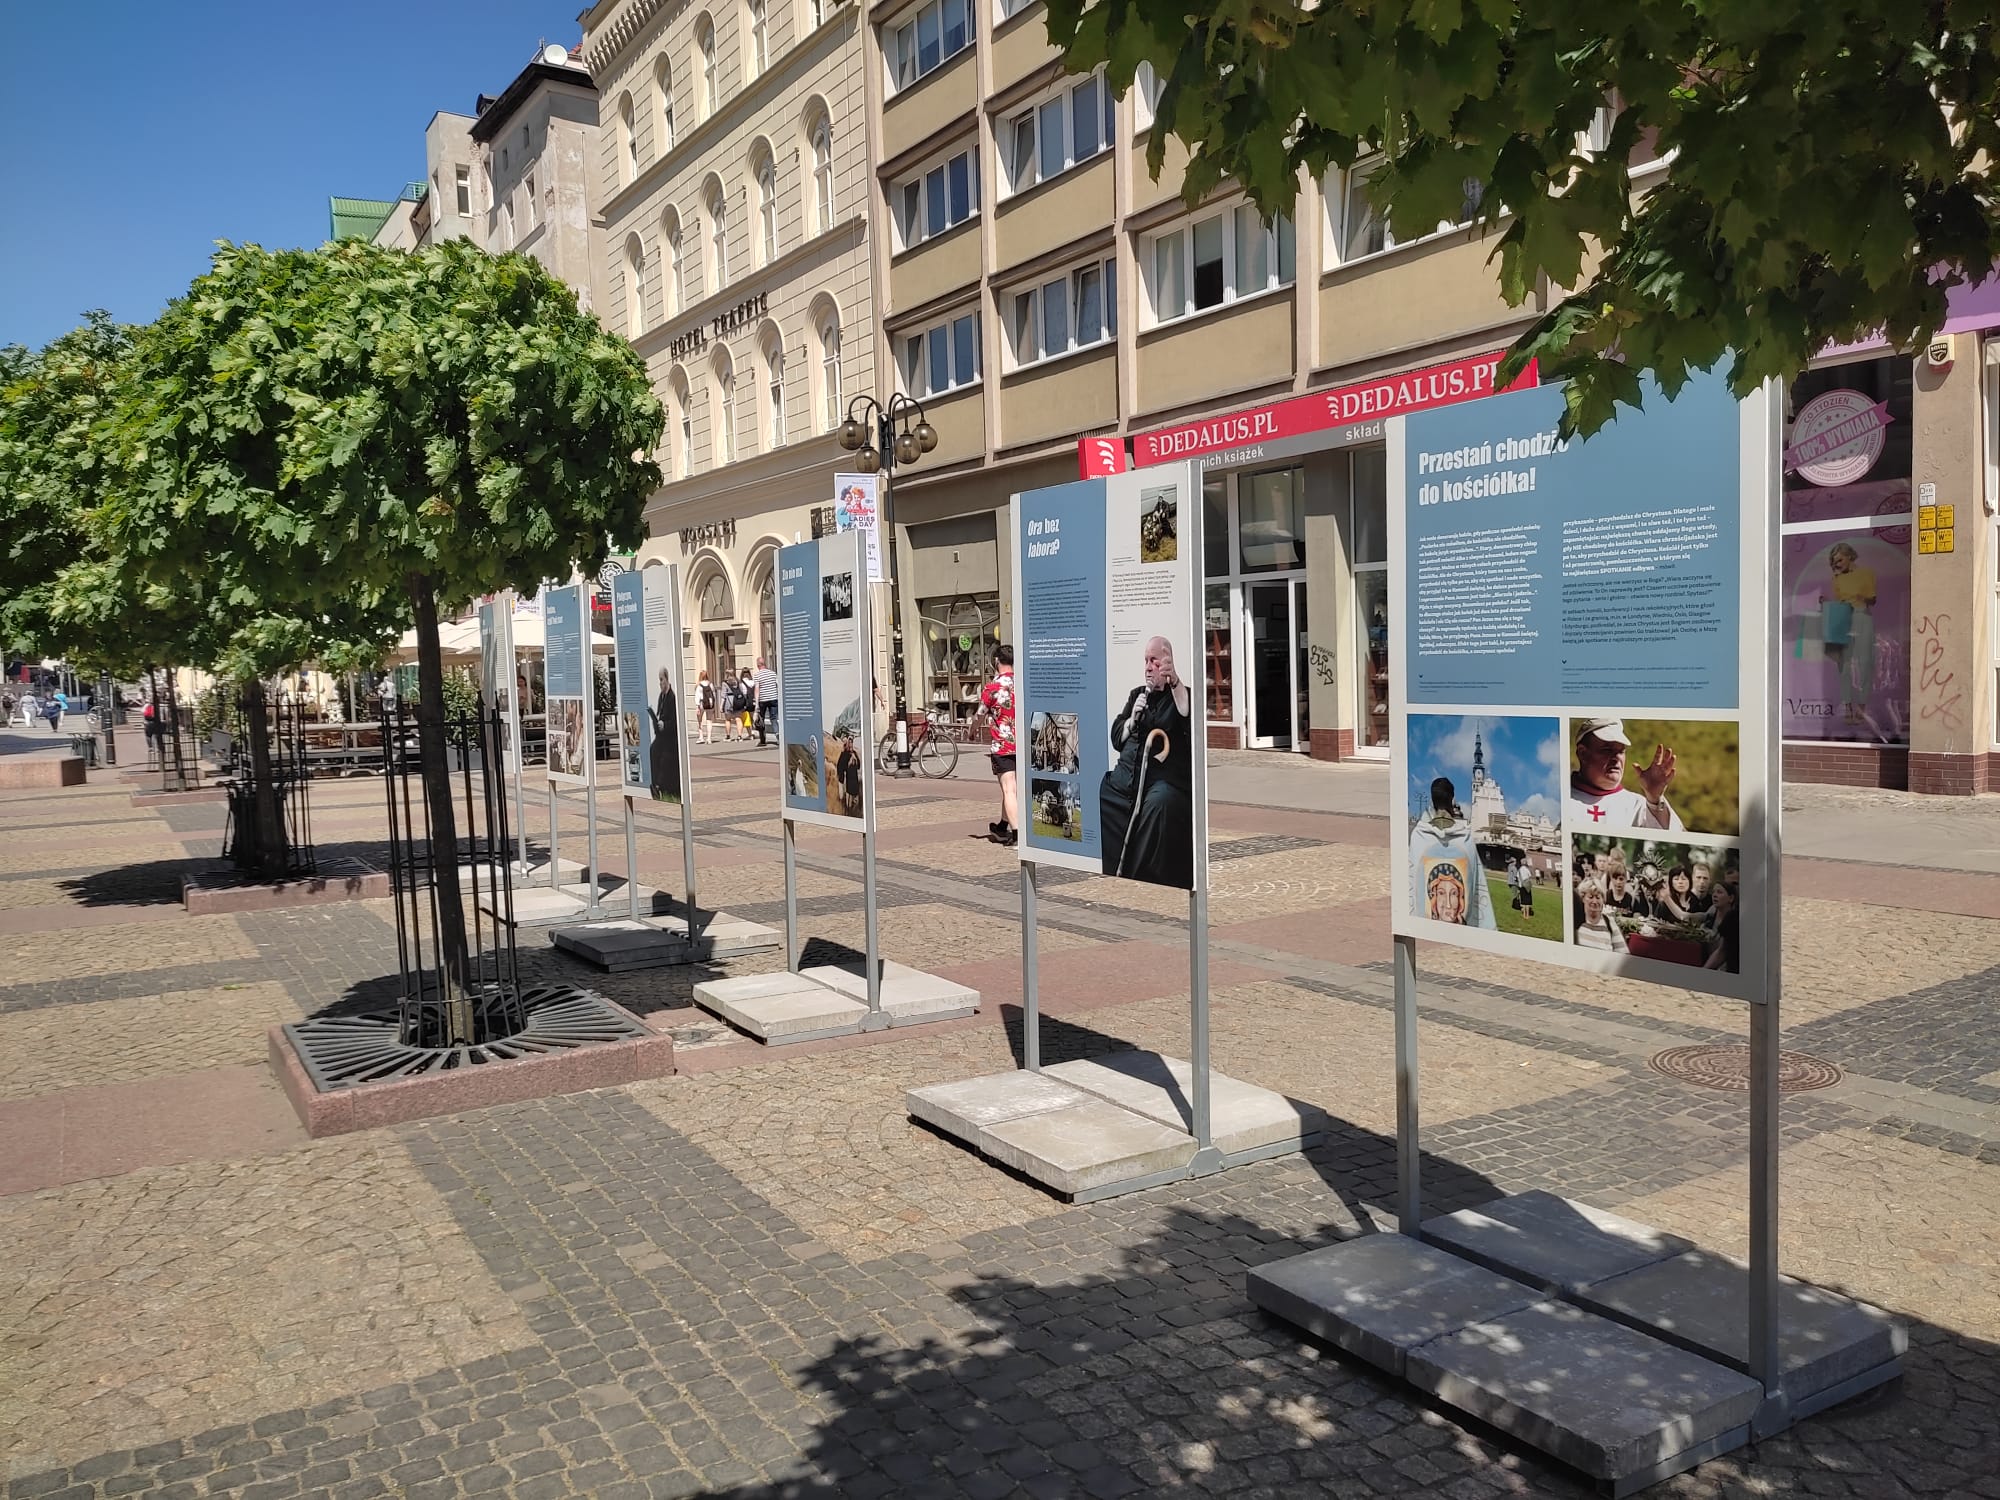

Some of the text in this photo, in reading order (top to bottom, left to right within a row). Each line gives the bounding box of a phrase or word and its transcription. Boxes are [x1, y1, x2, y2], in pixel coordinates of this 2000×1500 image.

[670, 291, 768, 358] HOTEL TRAFFIC
[1804, 412, 1814, 424] CO
[1160, 412, 1278, 456] DEDALUS.PL
[1345, 421, 1380, 441] skład
[1795, 409, 1881, 464] 100% WYMIANA
[1224, 445, 1265, 465] książek
[1419, 440, 1492, 475] Przestań
[1419, 467, 1536, 506] do kościółka!
[1028, 518, 1060, 536] Ora bez
[1028, 538, 1060, 558] labora?
[1786, 697, 1835, 717] Vena
